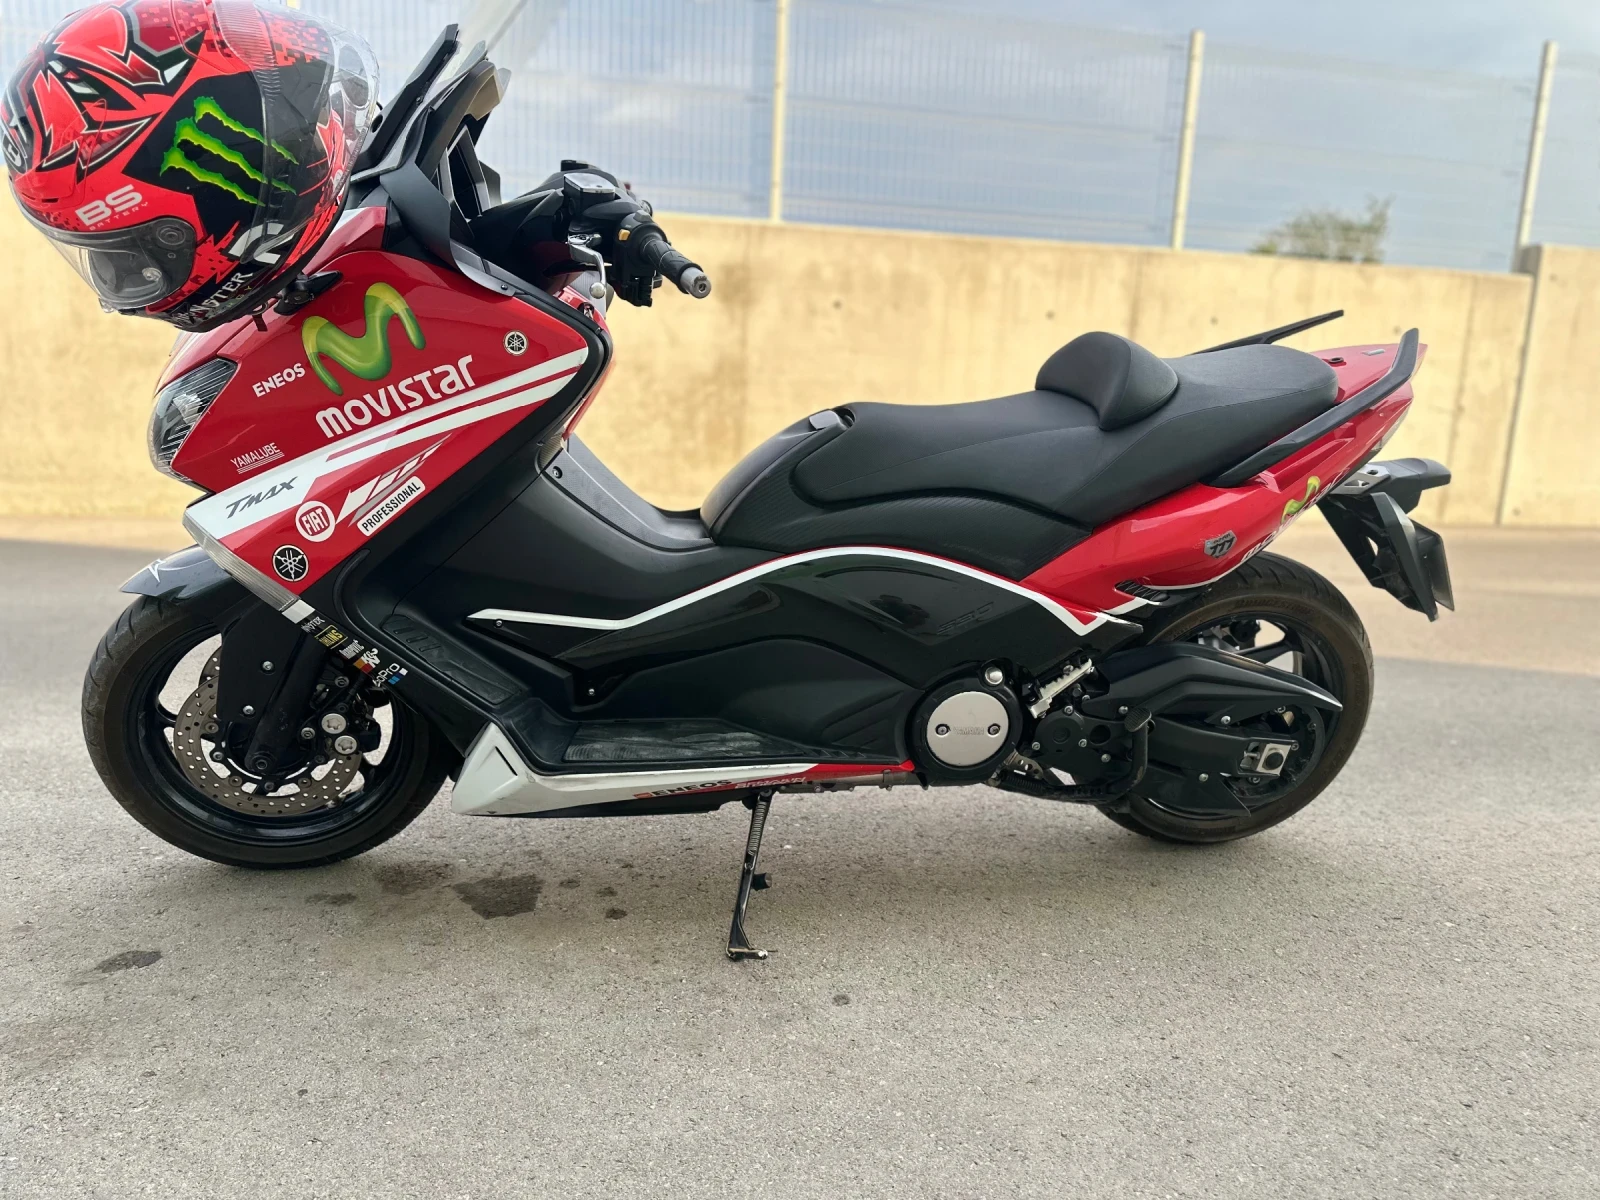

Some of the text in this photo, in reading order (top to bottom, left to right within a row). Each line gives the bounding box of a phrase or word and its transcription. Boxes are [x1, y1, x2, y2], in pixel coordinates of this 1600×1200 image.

[75, 184, 142, 226] BS
[89, 202, 148, 231] BATTERY
[172, 272, 253, 327] NSTER
[252, 363, 306, 397] ENEOS
[230, 442, 281, 469] YAMALUBE
[225, 476, 299, 519] TMAX
[361, 482, 421, 531] PROFESSIONAL
[301, 507, 329, 535] FIAT
